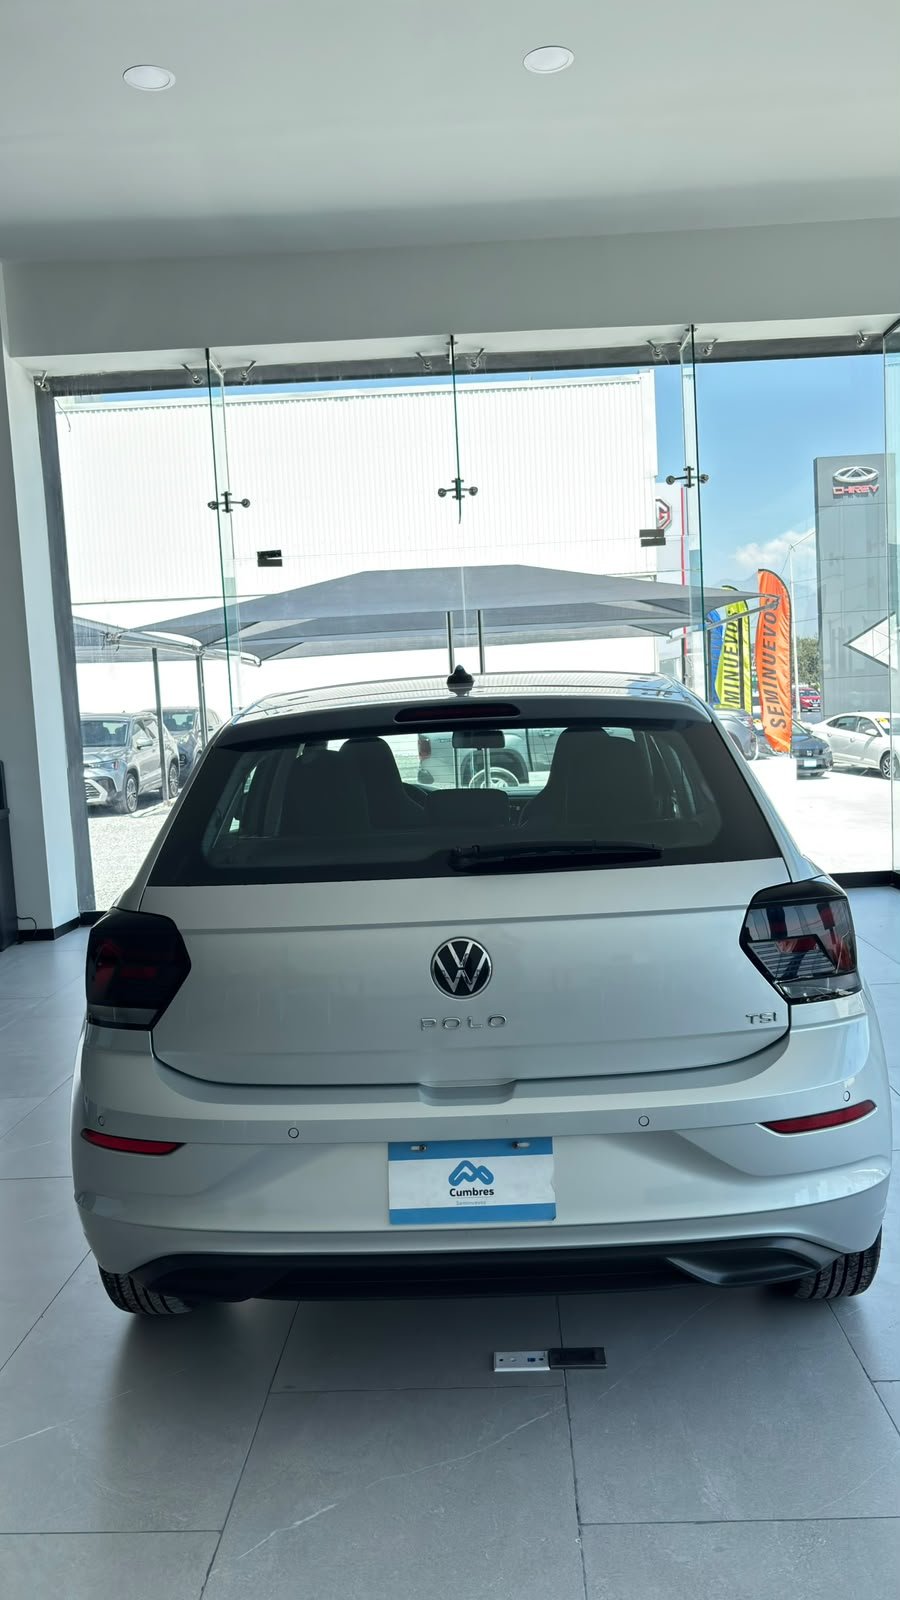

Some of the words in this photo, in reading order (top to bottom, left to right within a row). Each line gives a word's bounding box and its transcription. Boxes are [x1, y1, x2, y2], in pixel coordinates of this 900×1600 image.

[723, 608, 741, 705] MINUEVO
[420, 1014, 507, 1031] POLO
[745, 1011, 777, 1025] TSI
[449, 1187, 495, 1197] Cumbres
